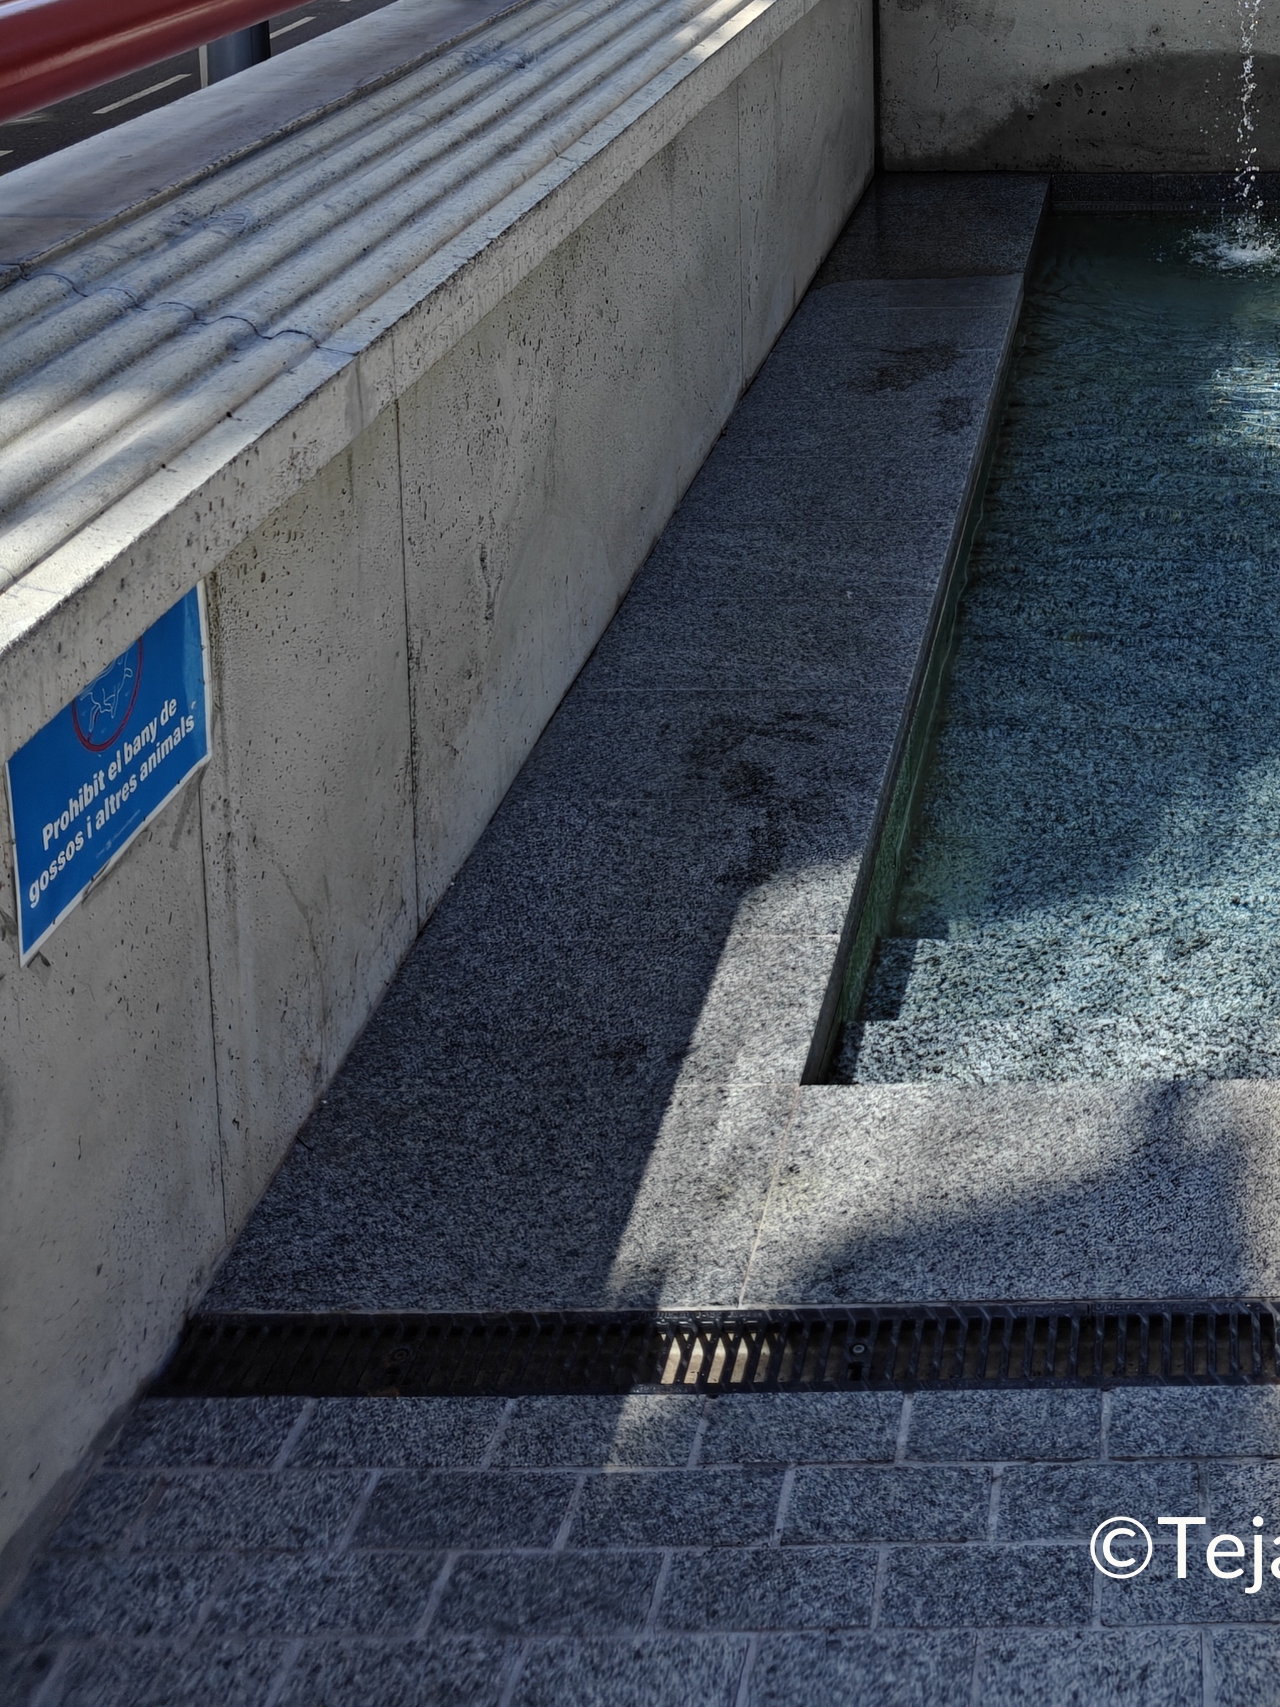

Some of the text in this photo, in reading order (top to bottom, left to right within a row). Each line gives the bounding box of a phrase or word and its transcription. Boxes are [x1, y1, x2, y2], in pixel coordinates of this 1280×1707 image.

[29, 830, 85, 909] gossos
[86, 815, 93, 839] i
[95, 773, 137, 831] altres
[139, 714, 195, 782] animals
[41, 769, 106, 851] Prohibit
[108, 749, 122, 781] el
[123, 716, 158, 765] bany
[160, 698, 178, 726] de
